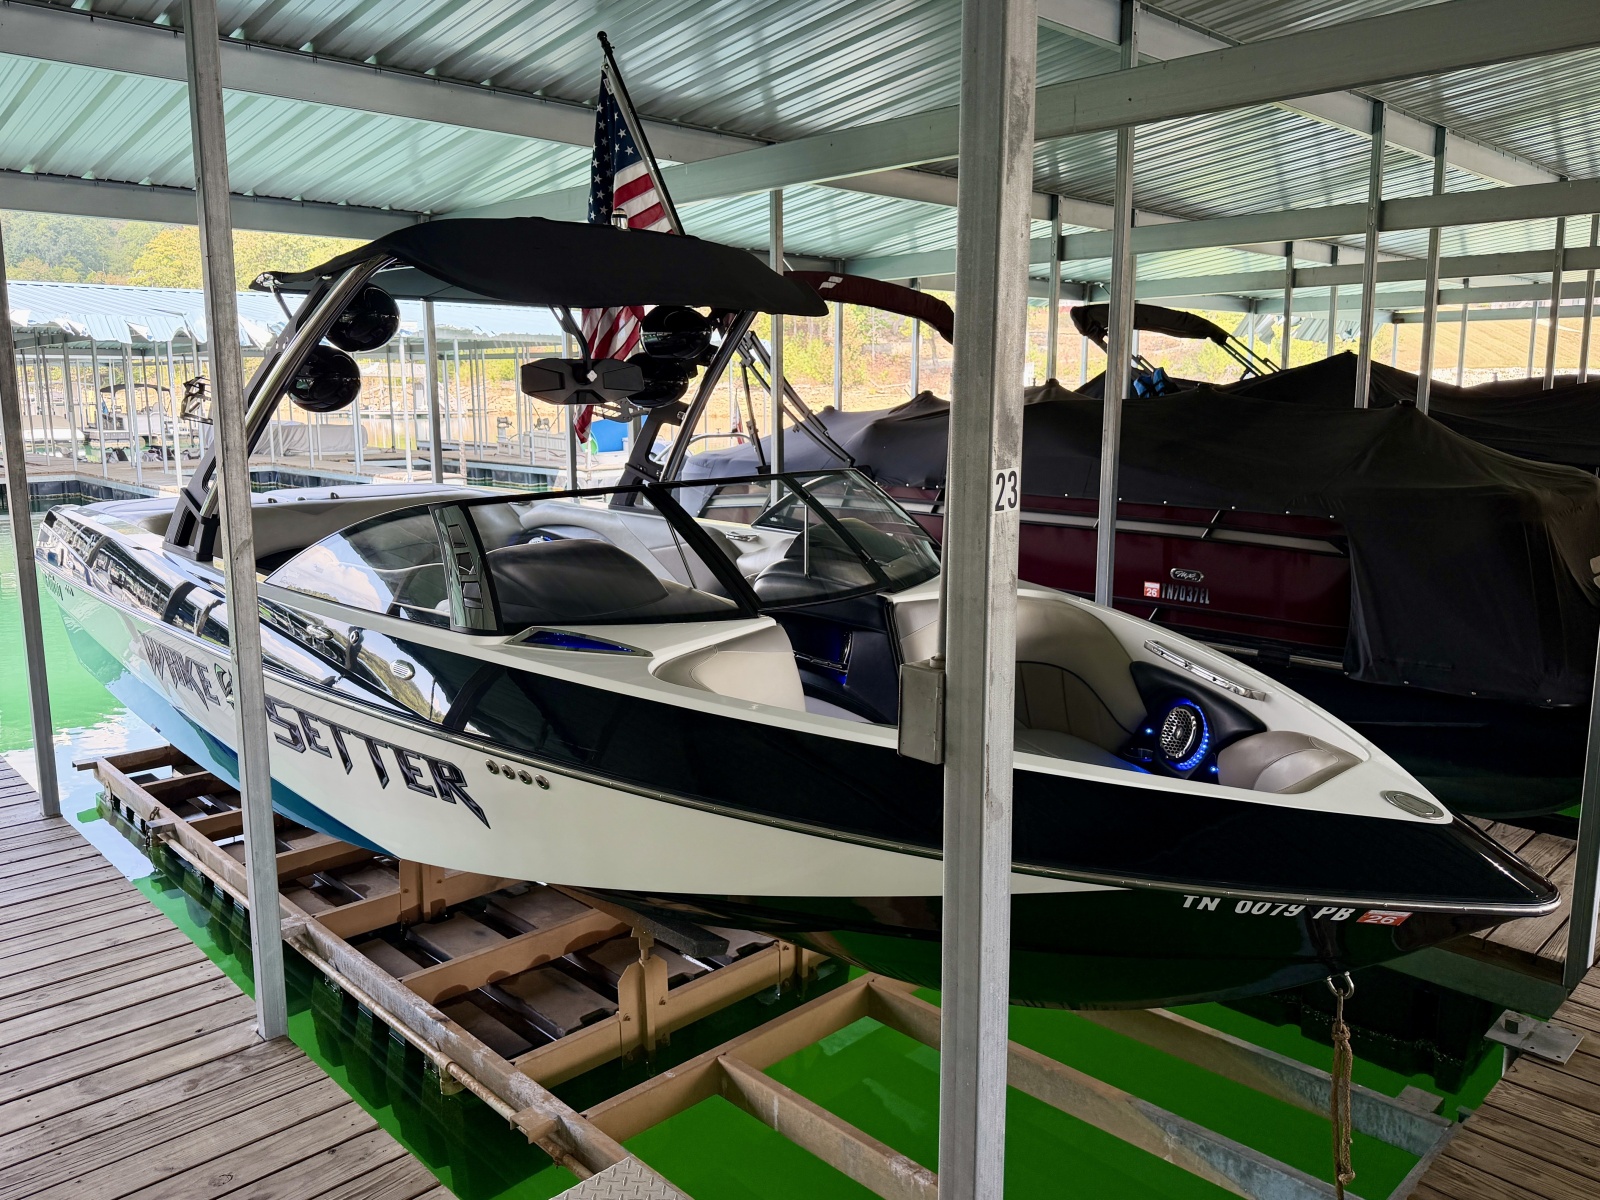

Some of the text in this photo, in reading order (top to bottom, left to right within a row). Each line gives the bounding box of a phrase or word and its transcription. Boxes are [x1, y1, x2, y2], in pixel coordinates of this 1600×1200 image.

[994, 470, 1018, 512] 23
[1146, 588, 1157, 597] 26
[137, 630, 491, 830] WAKE SETTER
[1182, 894, 1356, 922] TN 0079 PB
[1363, 914, 1398, 925] 26
